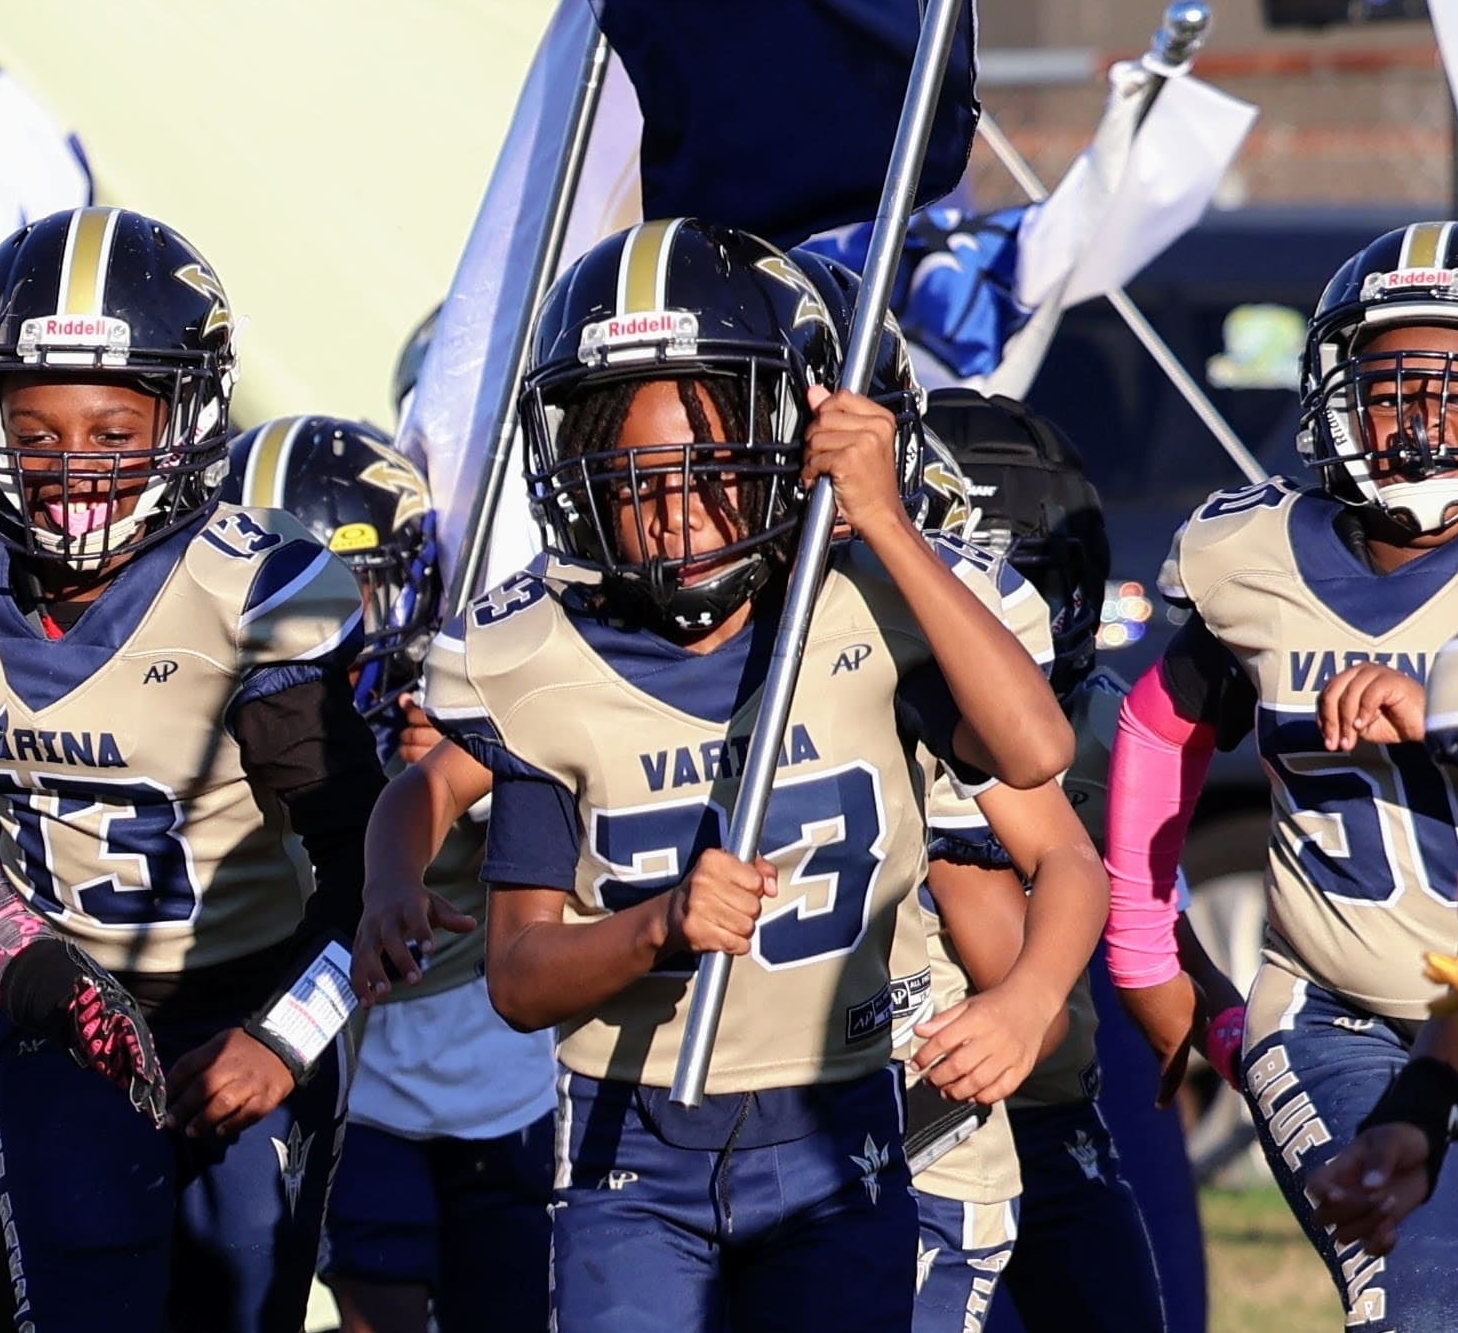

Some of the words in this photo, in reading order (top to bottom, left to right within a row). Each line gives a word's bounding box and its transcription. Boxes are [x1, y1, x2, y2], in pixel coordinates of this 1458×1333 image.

[46, 320, 107, 337] Riddell
[608, 316, 672, 337] Riddell
[142, 660, 178, 684] AP
[1246, 1044, 1333, 1174] BLUE
